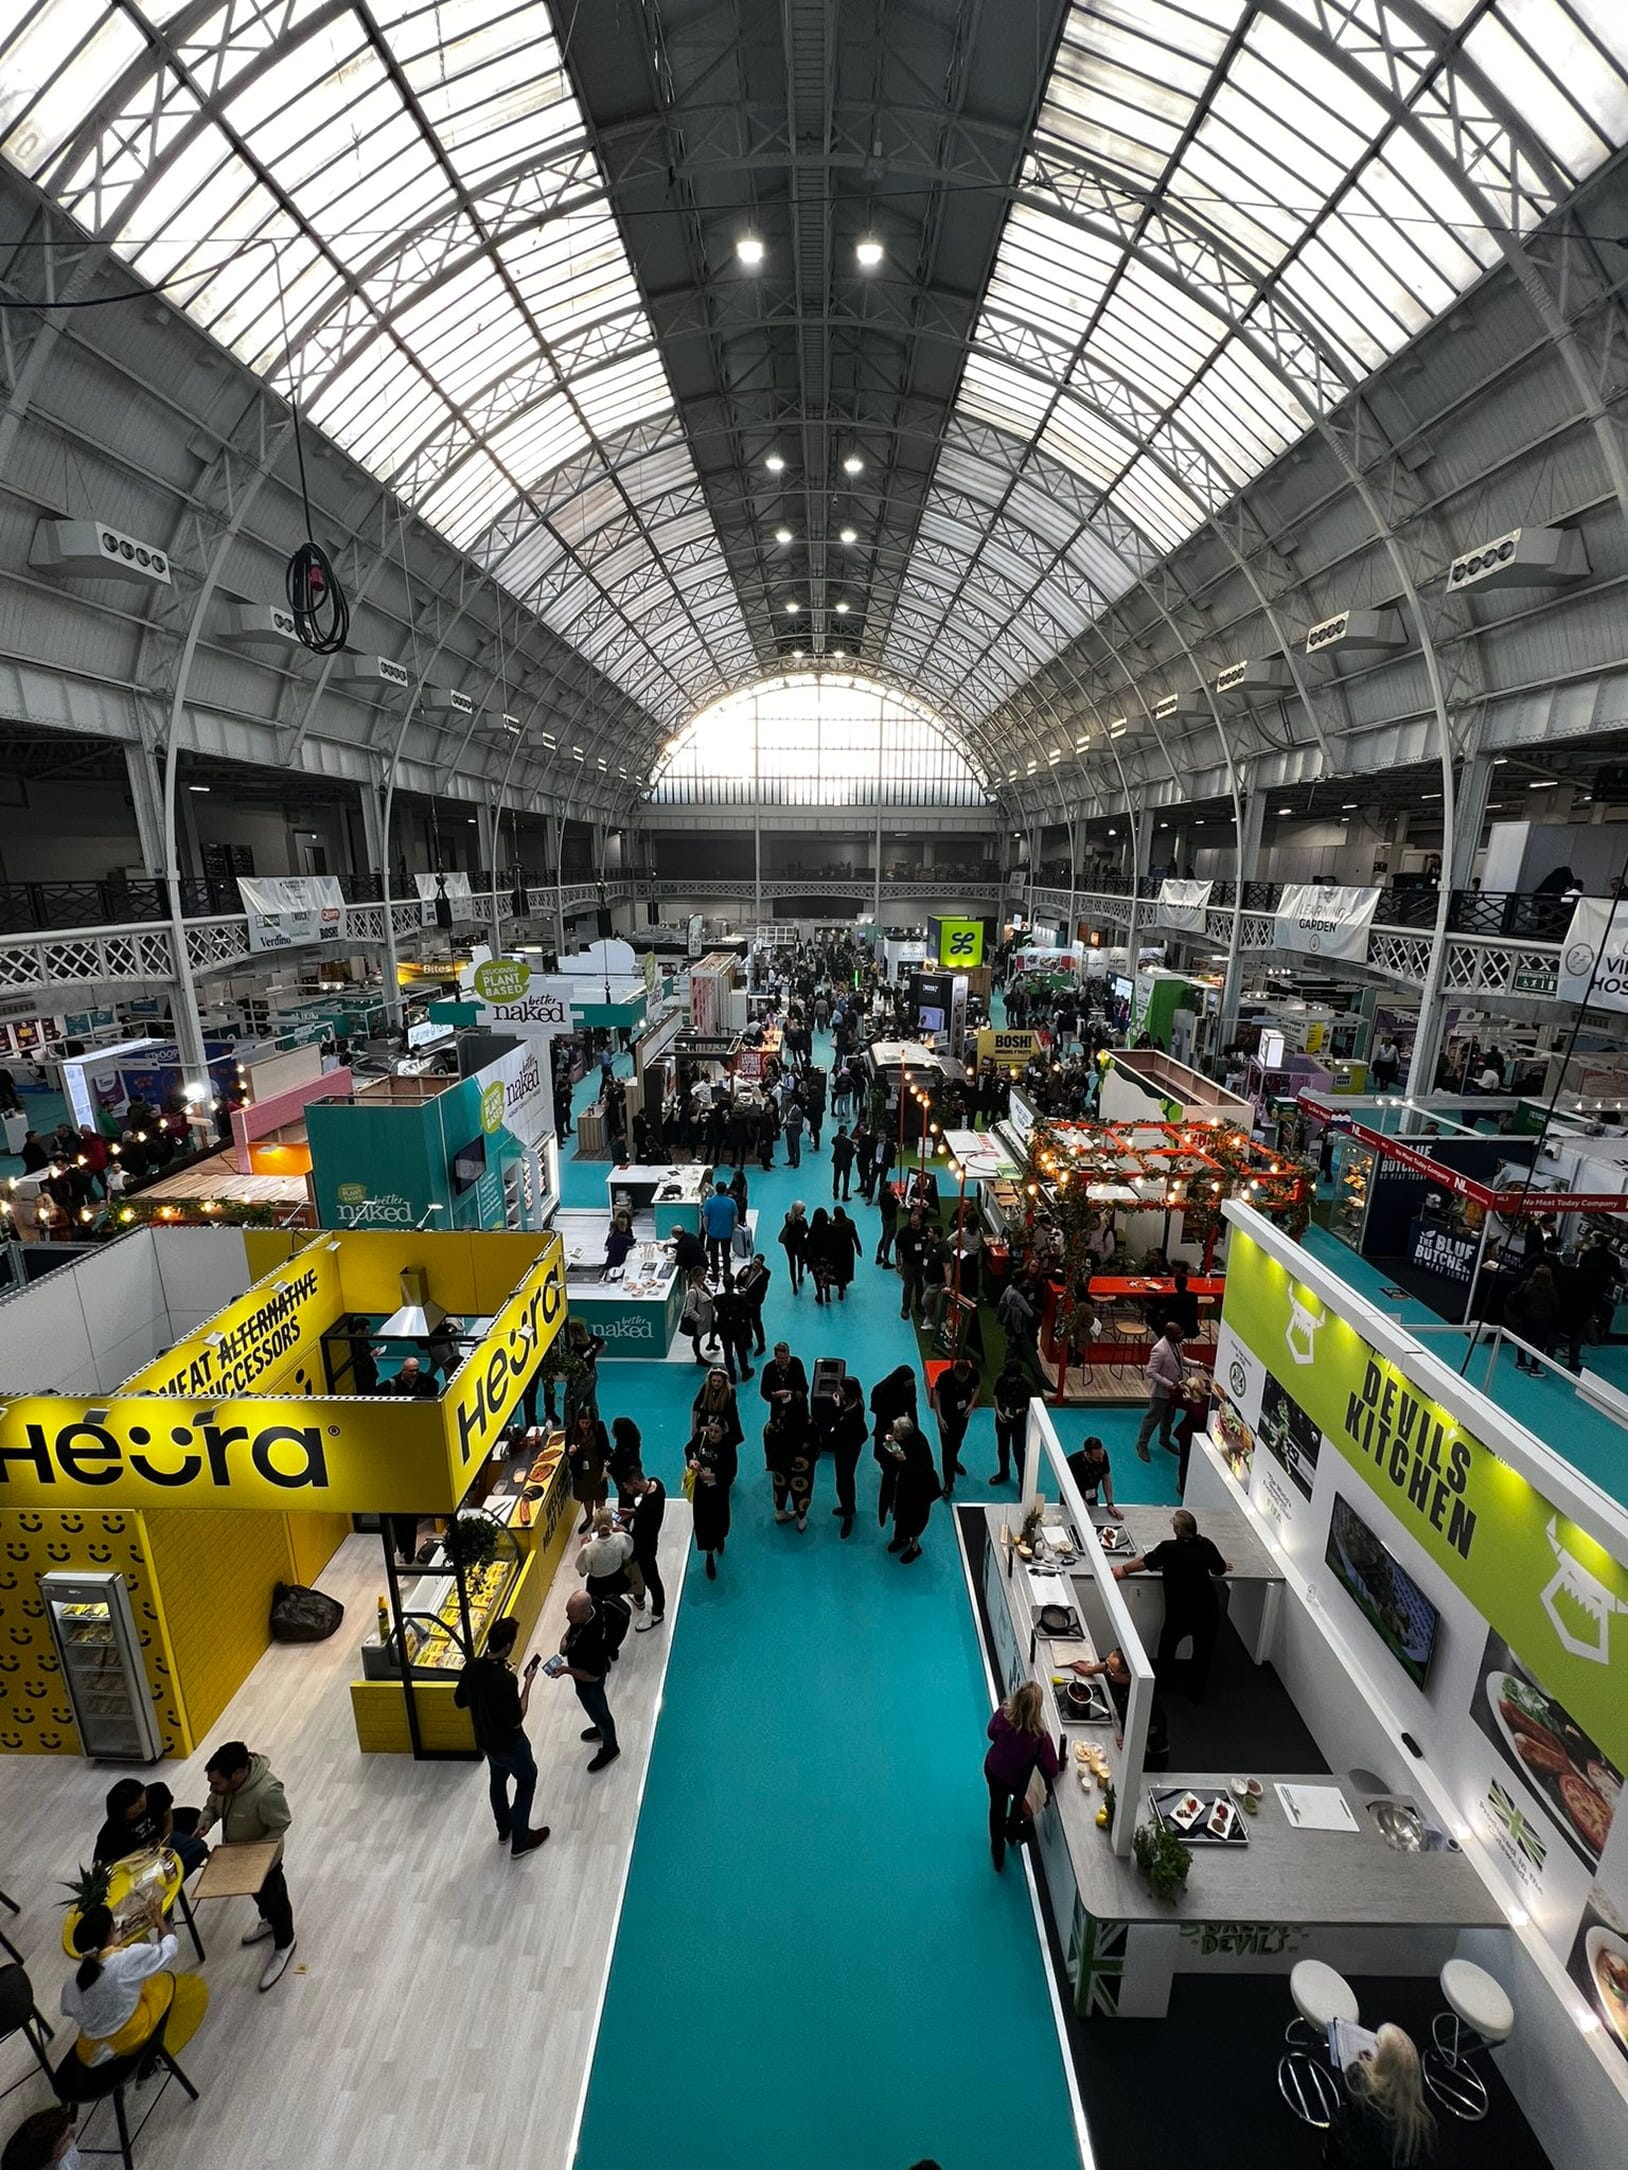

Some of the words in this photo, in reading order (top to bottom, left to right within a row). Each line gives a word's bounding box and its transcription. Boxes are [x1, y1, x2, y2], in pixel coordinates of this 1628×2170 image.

[1300, 904, 1346, 918] LEARNING
[1299, 918, 1338, 933] GARDEN
[260, 933, 292, 947] Verdino
[423, 964, 451, 974] Bites
[481, 966, 519, 976] DELICIOUSLY
[483, 973, 520, 987] PLANT
[485, 985, 523, 997] BASED
[528, 994, 557, 1006] better
[493, 1002, 567, 1023] naked
[995, 1035, 1032, 1048] BOSH!
[506, 1060, 540, 1107] naked
[1427, 1164, 1450, 1183] Company
[1454, 1176, 1468, 1193] NL
[1522, 1198, 1535, 1206] No
[1557, 1199, 1580, 1208] Today
[1581, 1199, 1619, 1208] Company
[337, 1201, 415, 1223] naked
[1419, 1235, 1433, 1248] THE
[217, 1268, 318, 1370] ALTERNATIVE
[621, 1314, 647, 1325] better
[591, 1321, 655, 1339] naked
[1362, 1359, 1471, 1494] DEVILS
[1344, 1391, 1477, 1560] KITCHEN
[1201, 1933, 1290, 1955] DEVILS
